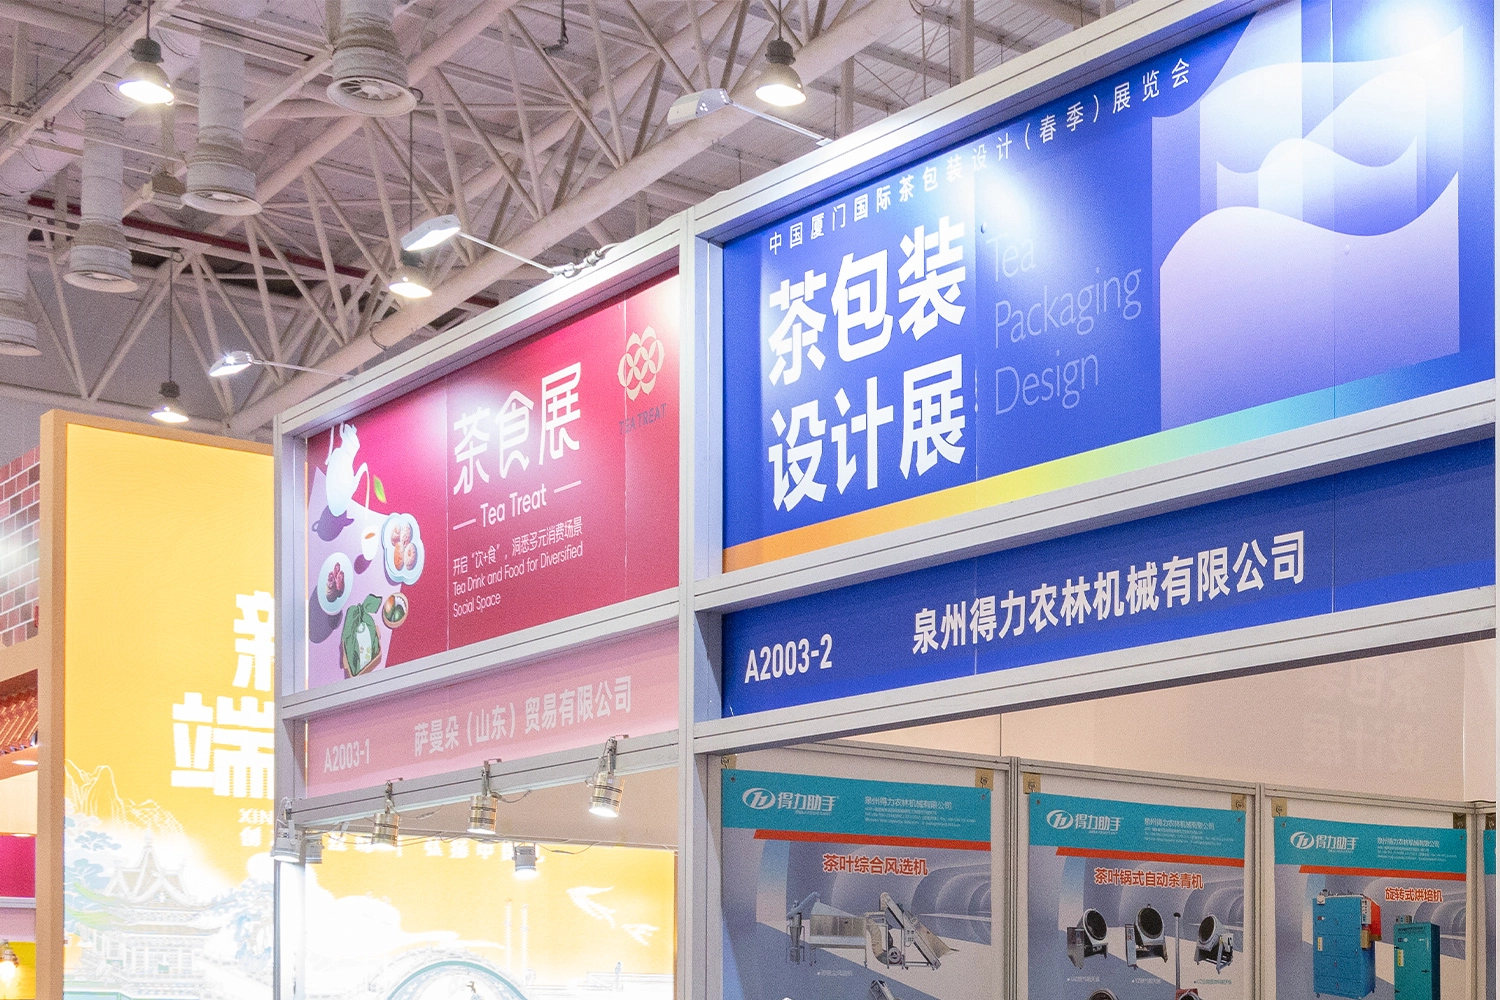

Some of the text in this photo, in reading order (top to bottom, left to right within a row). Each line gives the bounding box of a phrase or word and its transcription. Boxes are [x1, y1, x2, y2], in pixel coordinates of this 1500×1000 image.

[769, 57, 1190, 256] 中国厦门国际茶包装设计（春季）展览会
[985, 234, 1037, 284] Tea
[768, 215, 967, 387] 茶包装
[995, 267, 1142, 348] Packaging
[995, 349, 1099, 416] Design
[453, 361, 582, 496] 茶食展
[768, 353, 967, 513] 设计展
[480, 483, 547, 528] Tea Treat
[452, 540, 583, 597] Tea Drink and Food for Diversified
[912, 530, 1305, 655] 泉州得力农林机械有限公司
[452, 592, 501, 618] Social Space
[744, 633, 833, 684] A2003-2
[413, 675, 632, 758] 萨曼朵（山东）贸易有限公司
[323, 737, 370, 774] A2003-1
[777, 791, 837, 812] 得力助手
[1075, 813, 1122, 832] 得力助手
[822, 853, 929, 876] 茶叶综合风选机
[1315, 834, 1359, 851] 得力助手
[1094, 867, 1204, 890] 茶叶锅式自动杀青机
